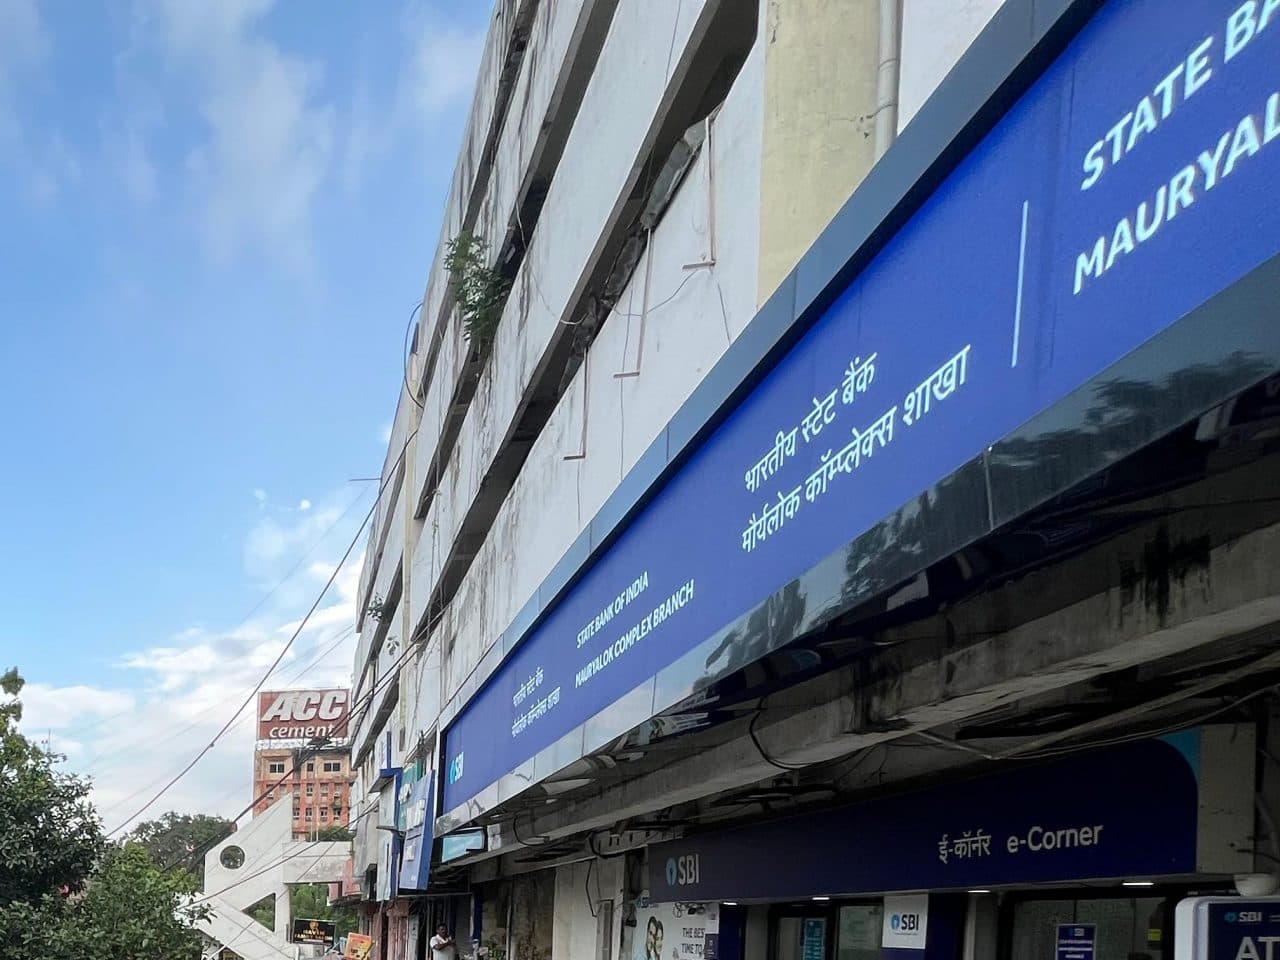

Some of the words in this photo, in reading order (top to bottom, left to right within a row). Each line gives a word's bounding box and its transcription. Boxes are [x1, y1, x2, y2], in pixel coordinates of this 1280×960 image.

[1080, 36, 1214, 190] STATE
[1073, 92, 1280, 295] MAURYAL
[745, 427, 798, 492] भारतीय
[801, 388, 838, 443] स्टेट
[841, 352, 878, 404] बैंक
[742, 485, 802, 552] मौर्यलोक
[805, 406, 898, 503] कॉम्प्लेक्स
[902, 344, 971, 426] शाखा
[576, 620, 595, 649] STATE
[595, 602, 615, 632] BANK
[614, 591, 626, 614] OF
[625, 571, 649, 605] INDIA
[575, 645, 615, 688] MAURYALOK
[614, 612, 653, 658] COMPLEX
[652, 579, 694, 628] BRANCH
[260, 690, 347, 720] ACC
[269, 723, 335, 738] cement
[454, 752, 464, 782] SBI
[937, 829, 992, 864] ई-कॉर्नर
[1007, 825, 1104, 854] e-Corner
[678, 853, 700, 886] SBI
[901, 914, 920, 931] SBI
[1238, 911, 1262, 922] SBI
[681, 943, 694, 954] TIME
[682, 927, 693, 938] THE
[694, 927, 706, 939] BES
